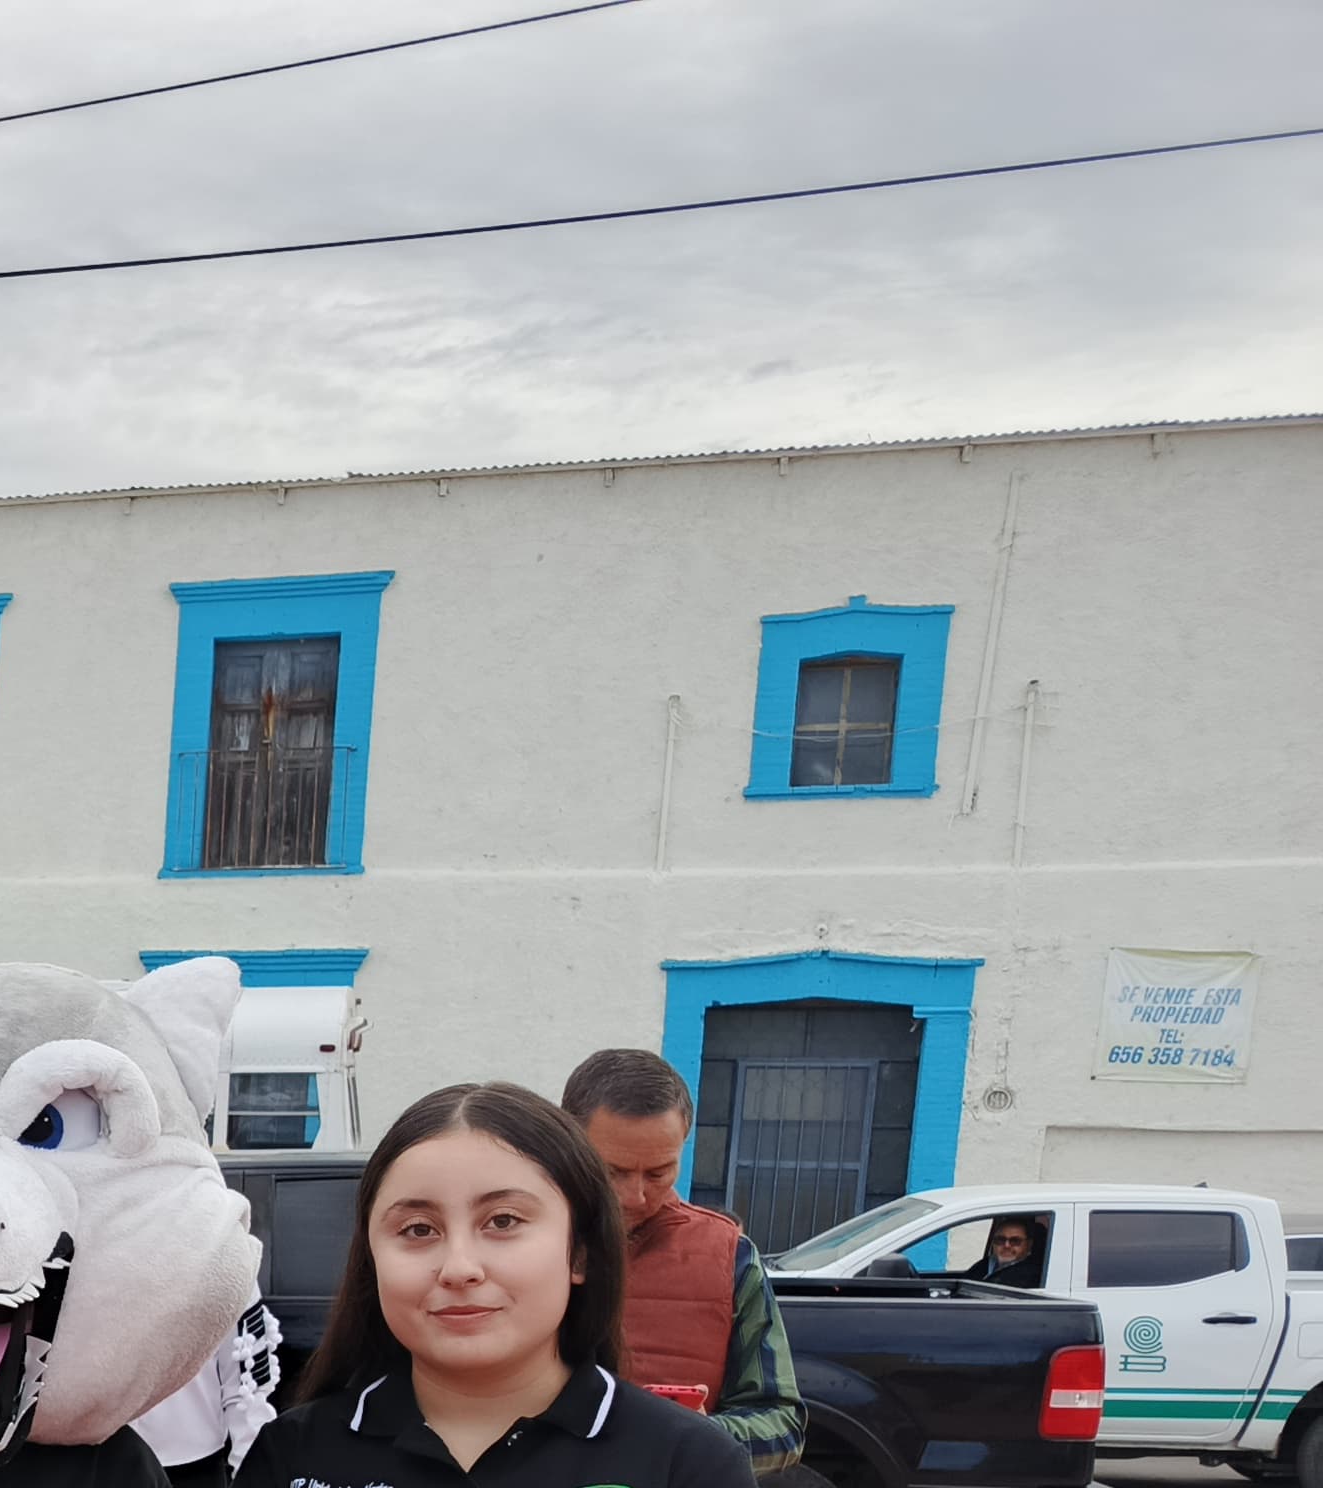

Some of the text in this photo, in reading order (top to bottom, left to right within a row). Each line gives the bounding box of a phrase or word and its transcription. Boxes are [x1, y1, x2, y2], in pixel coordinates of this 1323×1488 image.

[1118, 985, 1243, 1006] SE VENDE ESTA
[1130, 1006, 1226, 1025] PROPIEDAD
[1158, 1029, 1184, 1045] TEL:
[1108, 1046, 1235, 1067] 656 358 7184
